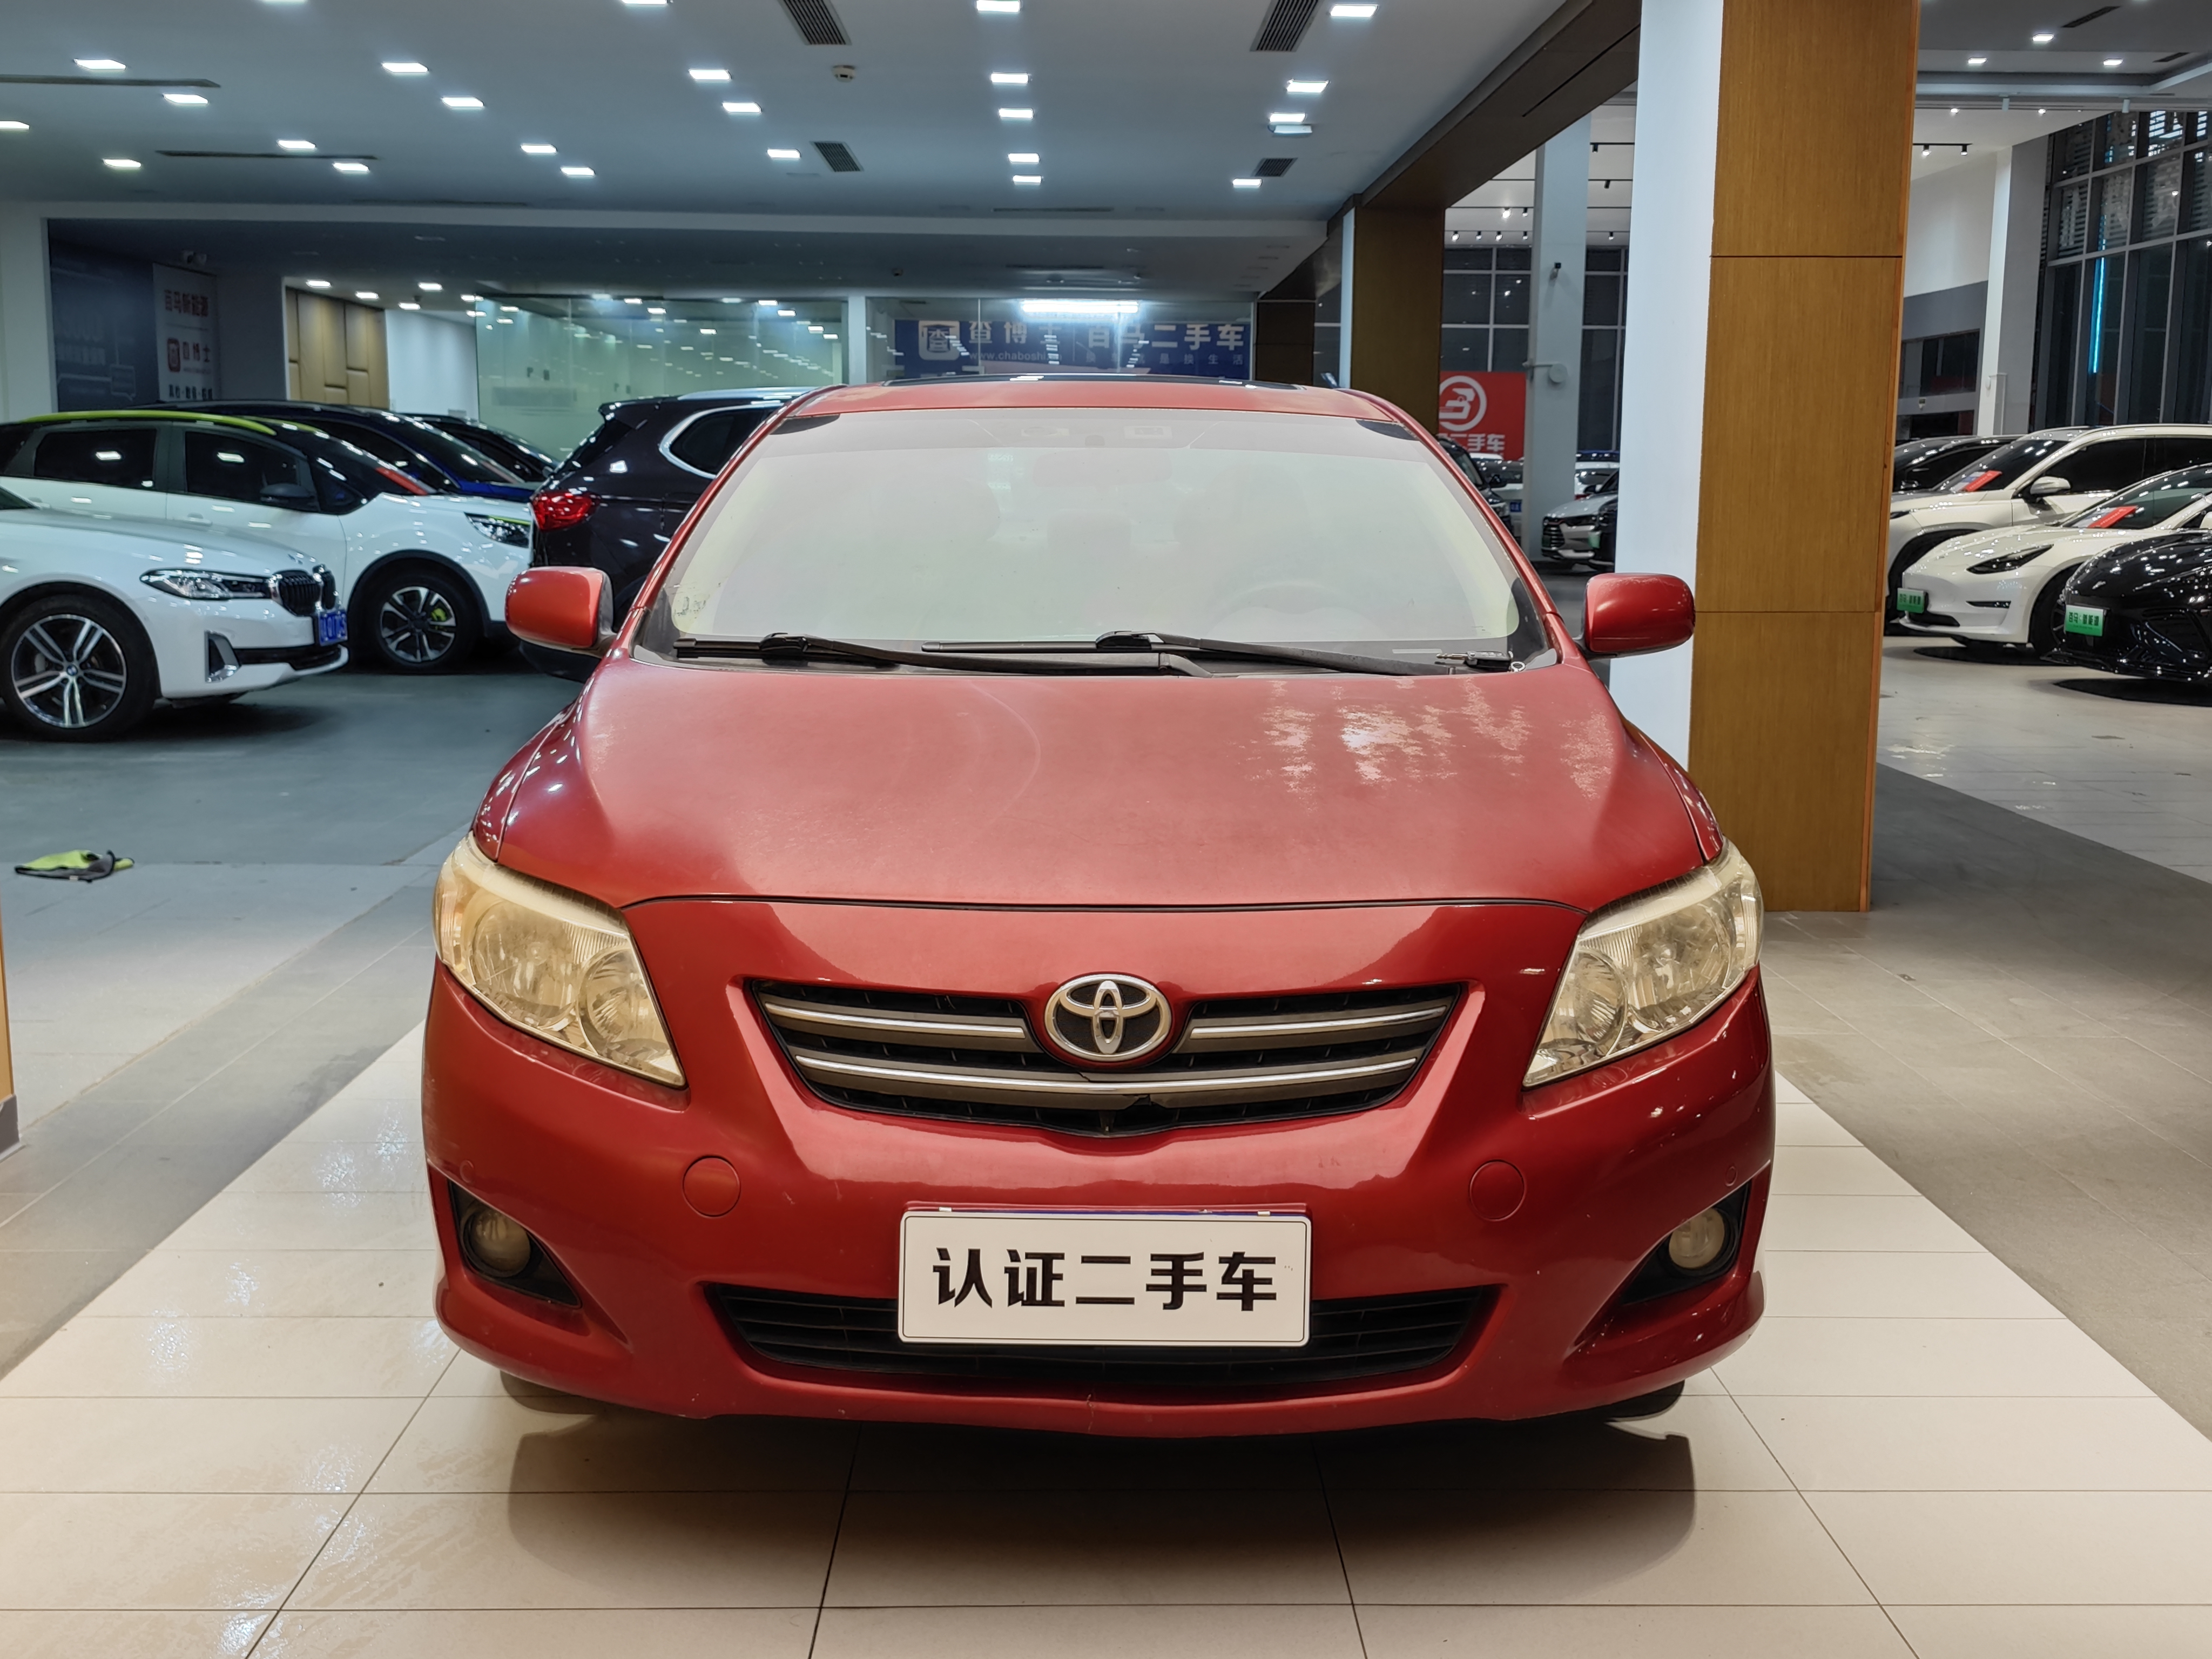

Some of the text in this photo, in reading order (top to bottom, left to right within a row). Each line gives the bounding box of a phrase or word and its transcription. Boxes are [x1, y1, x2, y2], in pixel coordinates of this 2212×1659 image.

[969, 321, 1244, 350] 查博士 百马二手车
[932, 1247, 1277, 1312] 认证二手车
